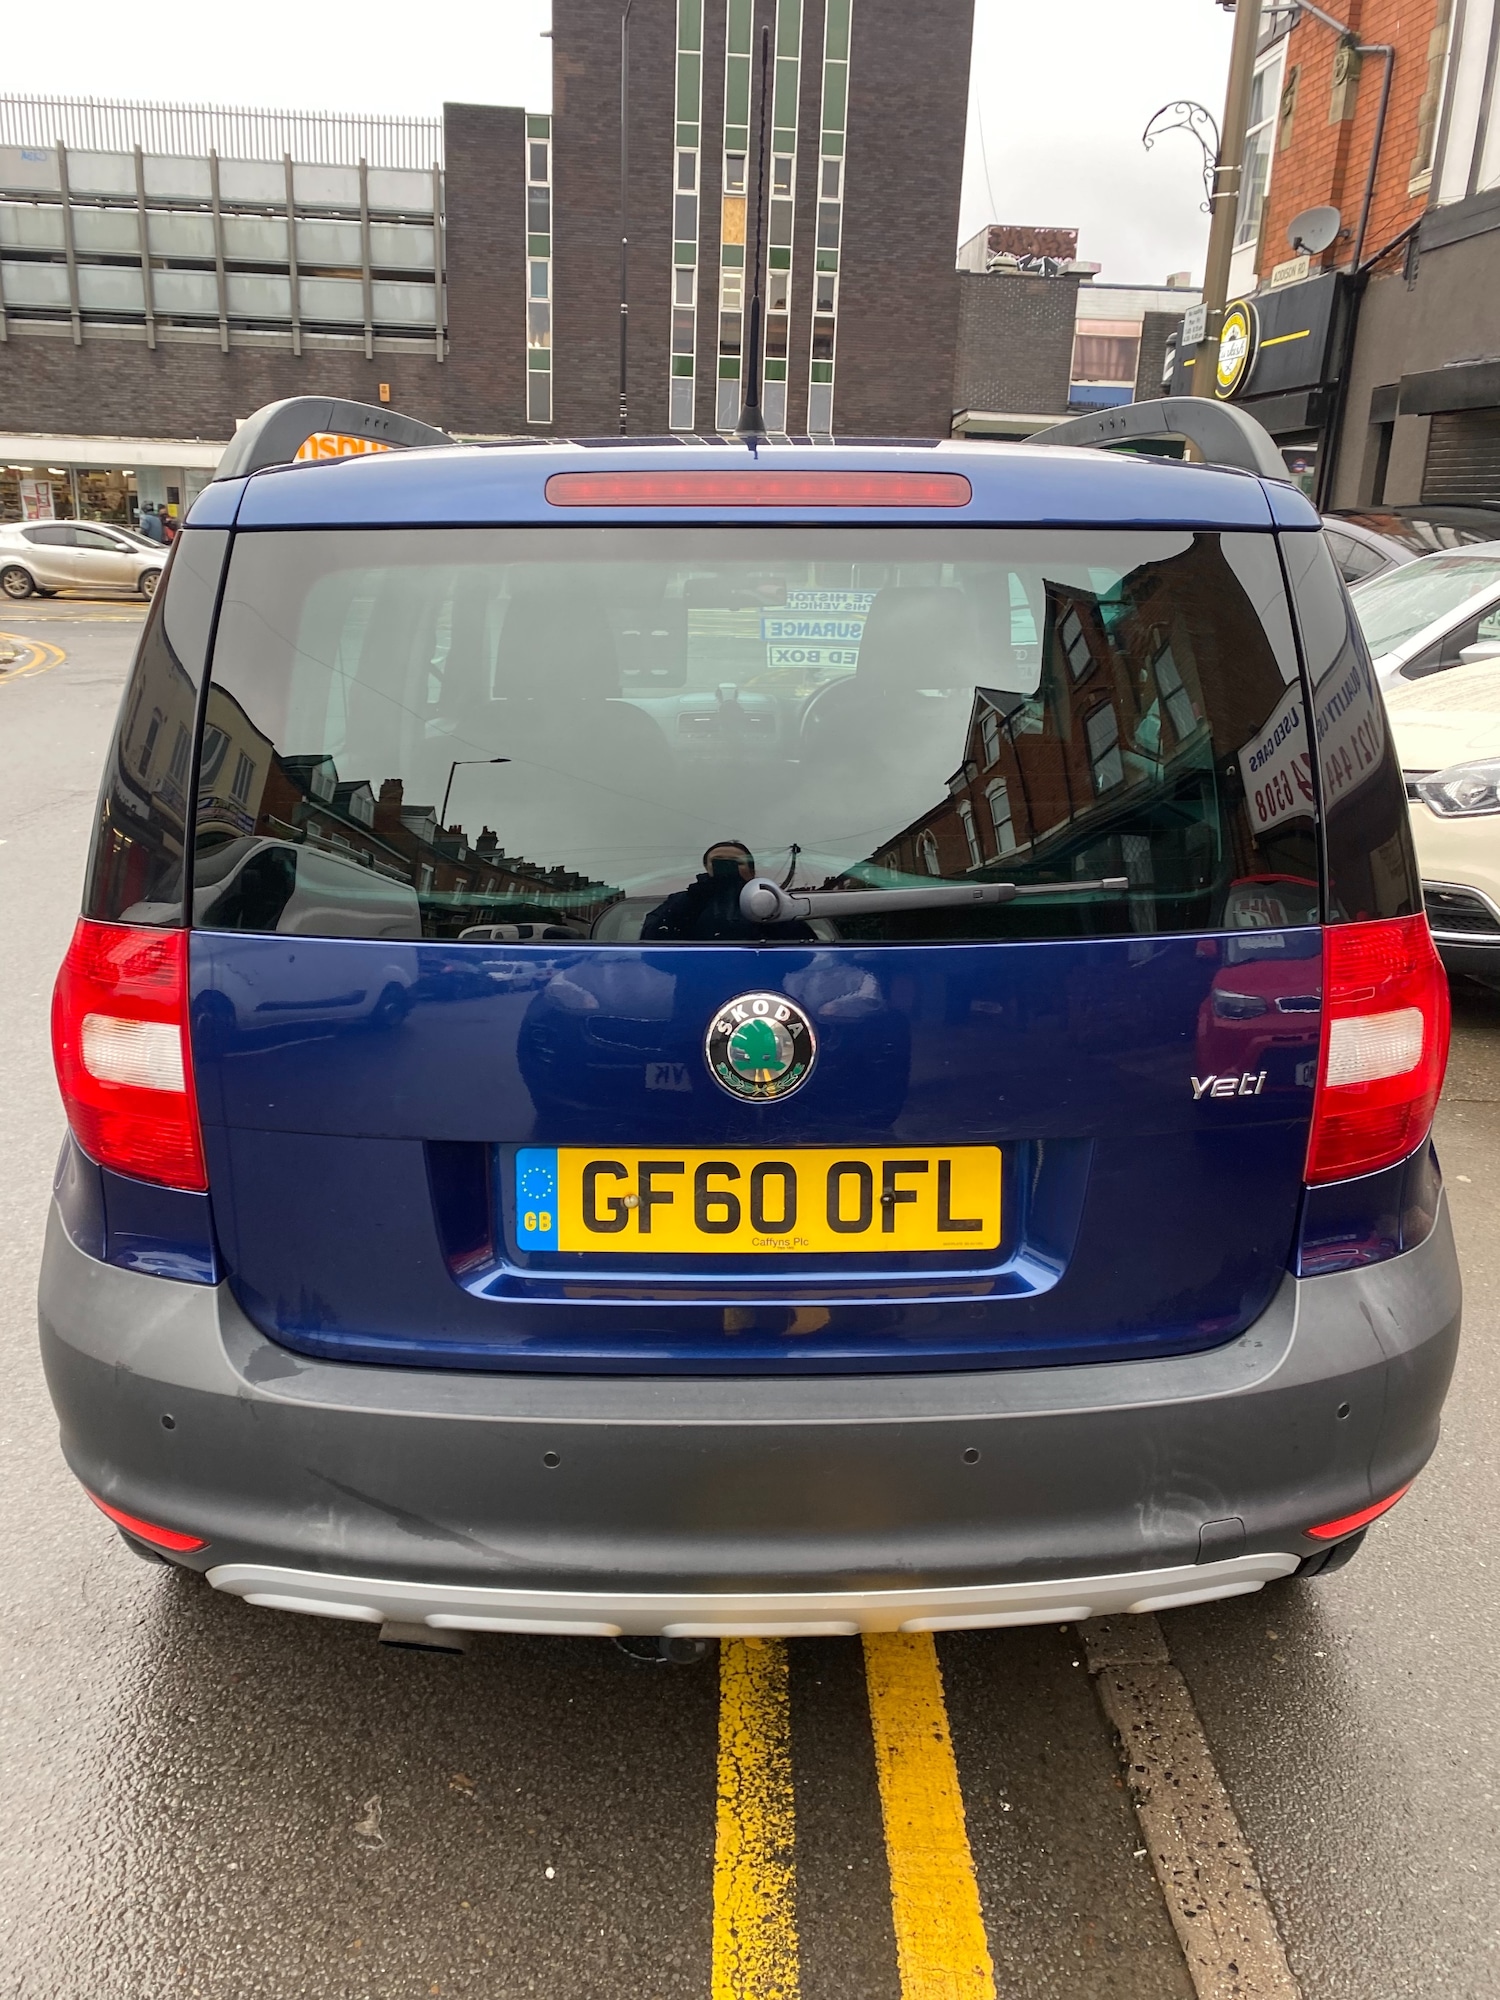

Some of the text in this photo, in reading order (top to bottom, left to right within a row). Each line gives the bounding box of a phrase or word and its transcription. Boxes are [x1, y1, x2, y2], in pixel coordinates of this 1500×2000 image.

[582, 1159, 983, 1234] GF60 OFL
[524, 1211, 552, 1232] GB
[752, 1237, 809, 1248] Caffyns Plc
